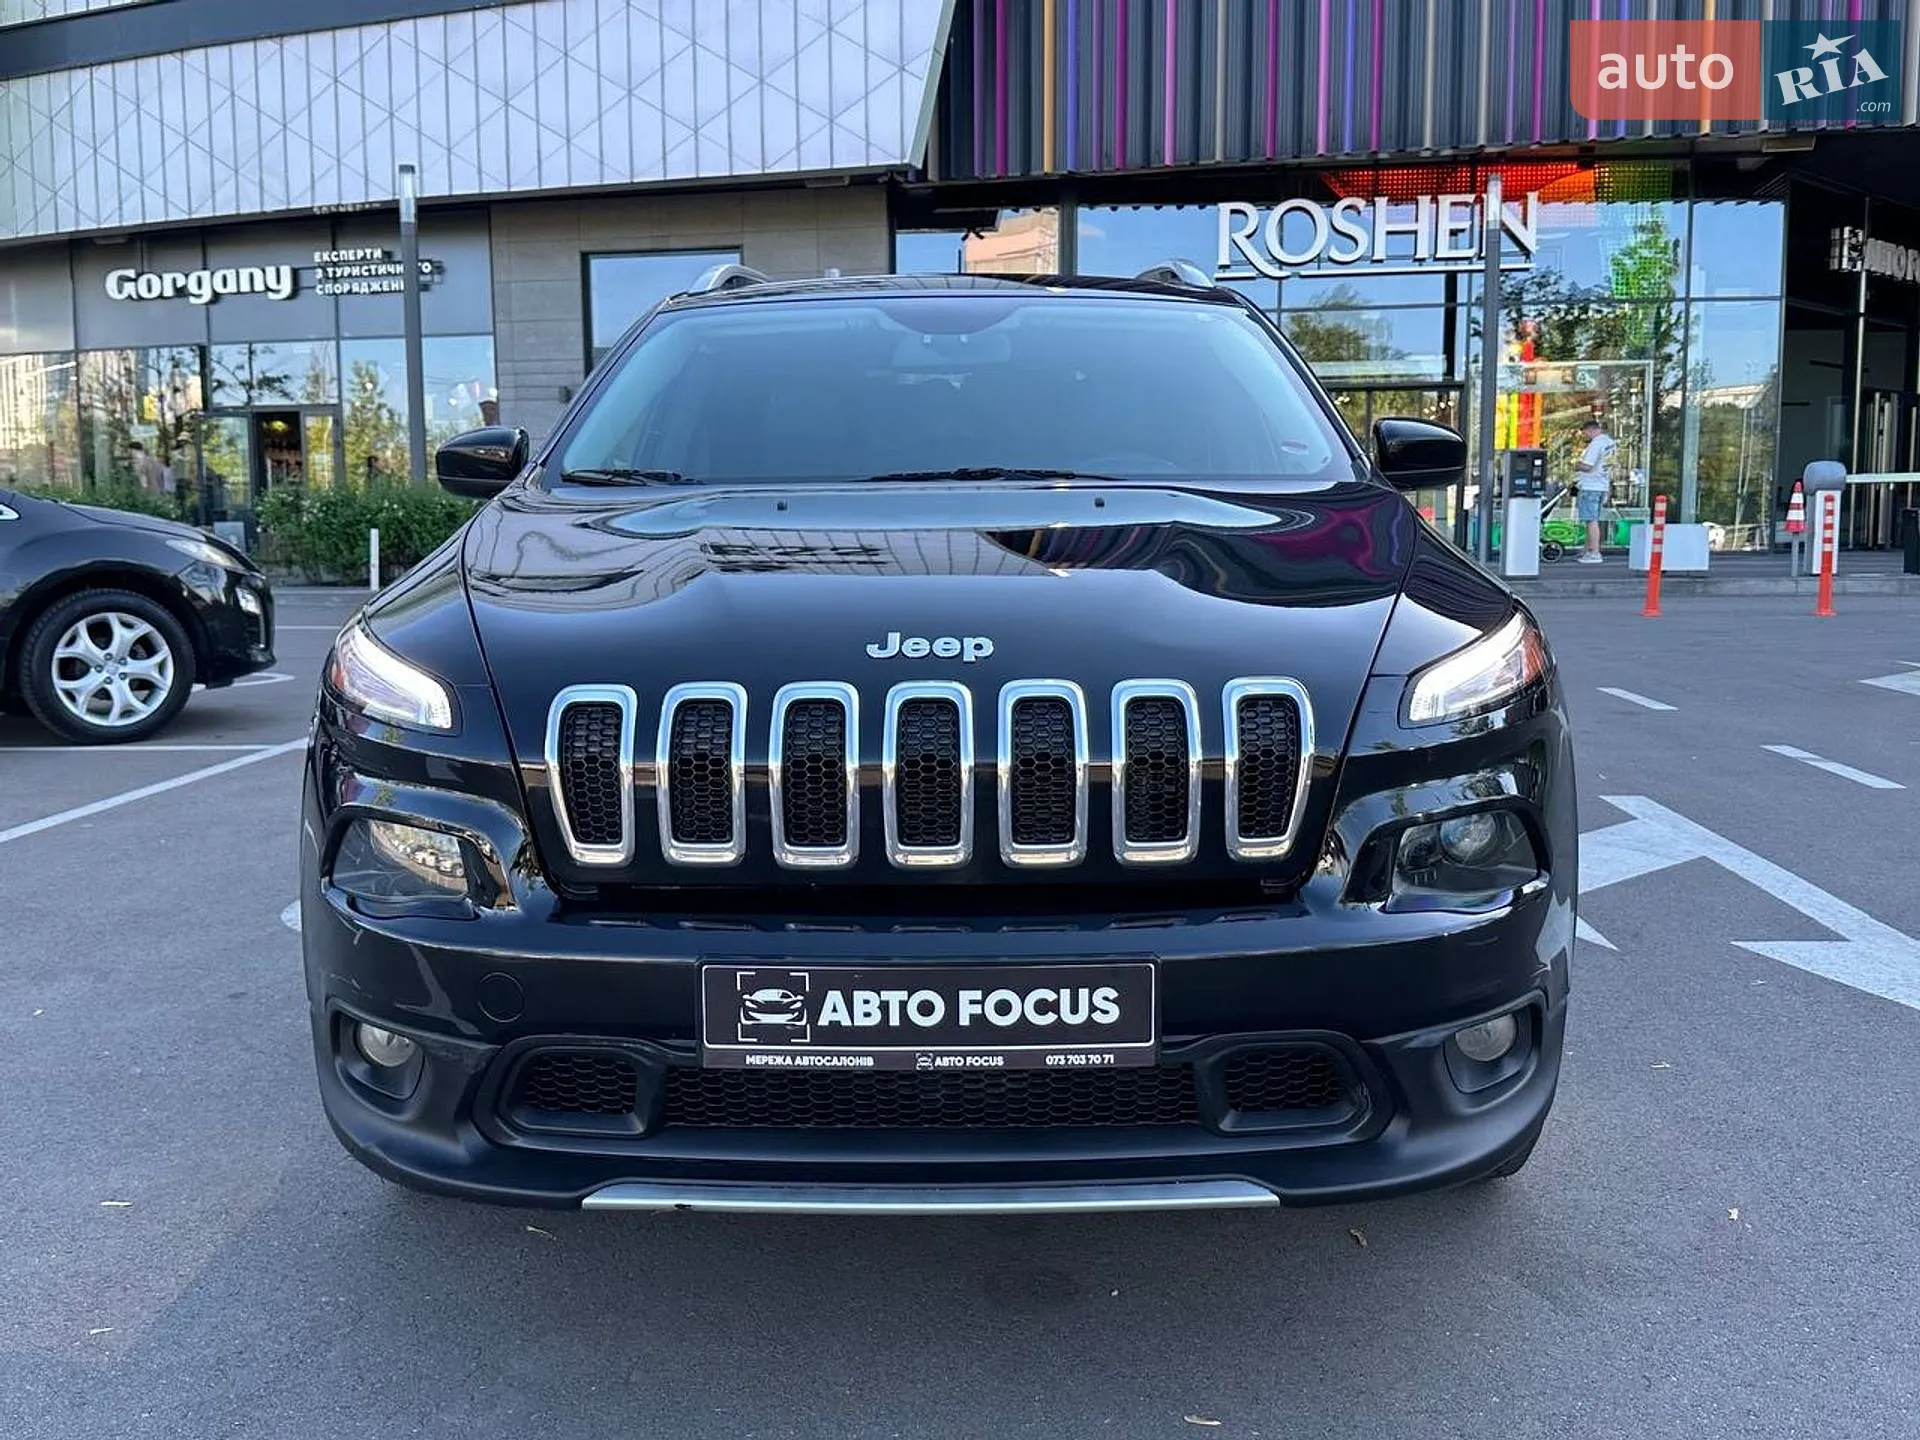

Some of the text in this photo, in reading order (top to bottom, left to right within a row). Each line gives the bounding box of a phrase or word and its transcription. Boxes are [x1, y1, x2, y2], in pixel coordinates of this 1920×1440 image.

[1217, 191, 1539, 279] ROSHEN
[313, 248, 383, 263] ЕКСПЕРТИ
[326, 262, 433, 279] ТУРИСТИЧНО
[105, 264, 294, 305] Gorgany
[865, 631, 995, 663] Jeep
[817, 987, 1120, 1028] АВТО FOCUS
[745, 1054, 874, 1067] МЕРЕЖА АВТОСАЛОНІВ
[934, 1055, 1004, 1067] АВТО FOCUS
[1045, 1054, 1115, 1065] 073 703 70 71
